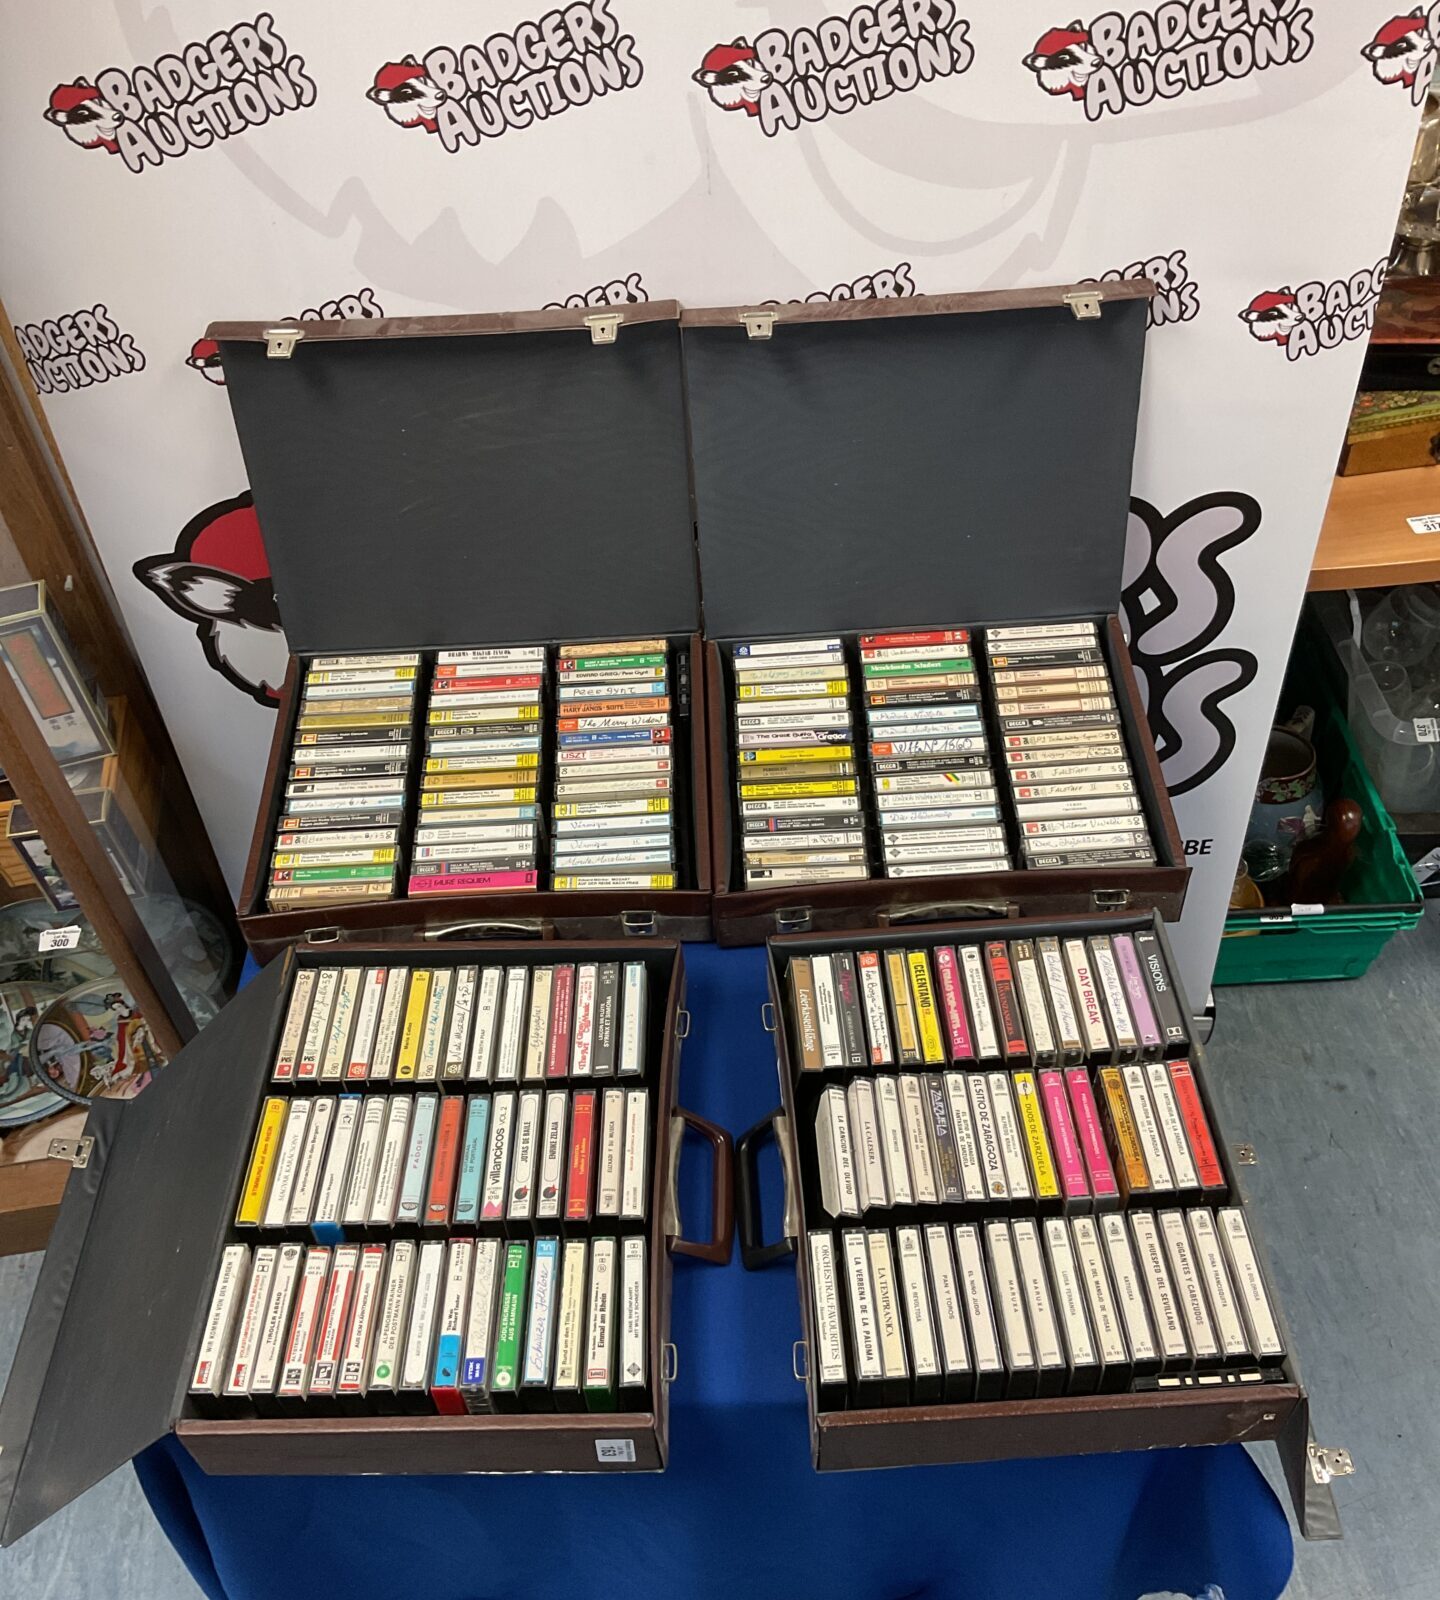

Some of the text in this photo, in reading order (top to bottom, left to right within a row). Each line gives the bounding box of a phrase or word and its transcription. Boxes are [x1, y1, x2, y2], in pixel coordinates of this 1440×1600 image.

[97, 12, 287, 125] BADGERS
[423, 0, 618, 101] BADGERS
[752, 0, 956, 85] BADGERS
[1085, 9, 1314, 121] AUCTIONS
[438, 35, 643, 153] AUCTIONS
[758, 20, 974, 137] AUCTIONS
[115, 55, 317, 173] AUCTIONS
[14, 304, 119, 359] ADGERS
[27, 334, 146, 394] UCTIONS
[1416, 724, 1428, 737] 370
[1181, 838, 1214, 856] BE
[50, 938, 69, 948] 300
[914, 965, 931, 1008] CELENTANO
[1077, 968, 1100, 1025] DAY BREAK
[1147, 954, 1166, 992] VISIONS
[799, 989, 816, 1052] Leierkastenklänge
[522, 1121, 531, 1136] BAILE
[548, 1140, 557, 1159] ENRIKE
[865, 1121, 875, 1165] LA CALESERA
[973, 1079, 998, 1171] EL SITIO DE ZARAGOZA
[1025, 1104, 1046, 1175] DUOS DE ZARZUELA
[489, 1128, 505, 1185] villancicos
[520, 1146, 529, 1163] JOTAS
[839, 1127, 847, 1153] CANCION
[844, 1172, 852, 1195] OLVIDO
[960, 1144, 969, 1168] ZARZUELA
[206, 1261, 233, 1353] WIR KOMMEN VON DEN BERGEN
[391, 1299, 402, 1335] POSTMANN
[397, 1274, 405, 1298] KOMMT
[821, 1245, 840, 1360] ORCHESTRAL FAVOURITES
[854, 1257, 873, 1361] LA VERBENA DE LA PALOMA
[877, 1267, 894, 1337] LA TEMPRANICA
[911, 1282, 918, 1290] LA
[945, 1297, 954, 1320] TOROS
[972, 1298, 981, 1316] JUDIO
[1008, 1280, 1018, 1313] MARUXA
[1032, 1279, 1043, 1312] MARUXA
[1062, 1270, 1076, 1316] LUISA FERNANDA
[1094, 1280, 1103, 1303] MANOJO
[1145, 1232, 1176, 1331] EL HUESPED DEL SEVILLANO
[1176, 1242, 1190, 1275] GIGANTES
[1186, 1284, 1203, 1326] CABEZUDOS
[266, 1292, 282, 1344] TIROLER ABEND
[382, 1279, 396, 1344] ALPENOBERKRAINER
[597, 1293, 607, 1348] Einmal am Rhein
